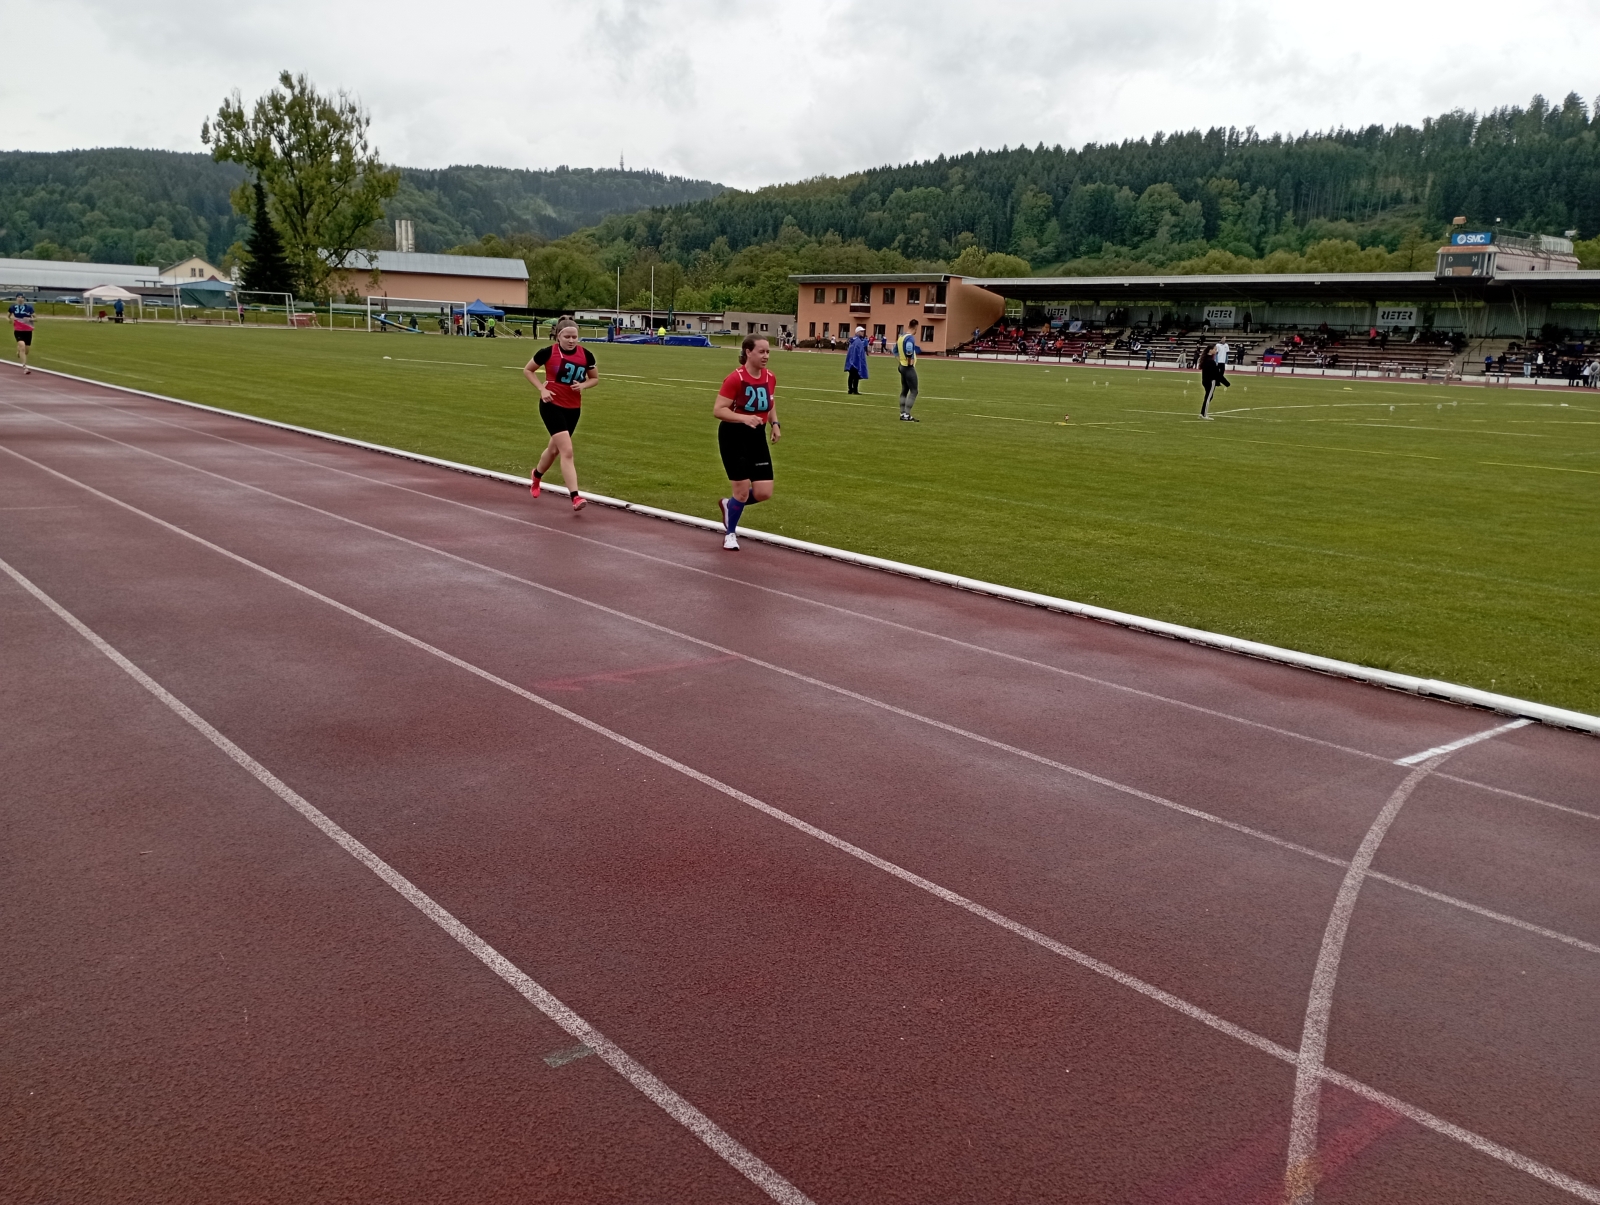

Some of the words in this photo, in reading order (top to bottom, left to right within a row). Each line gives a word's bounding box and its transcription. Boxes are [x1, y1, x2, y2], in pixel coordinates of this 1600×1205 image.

[1466, 234, 1485, 243] SMC
[14, 305, 26, 314] 32
[1207, 309, 1232, 318] RIETER
[1381, 310, 1413, 320] RIETER
[745, 386, 768, 411] 28
